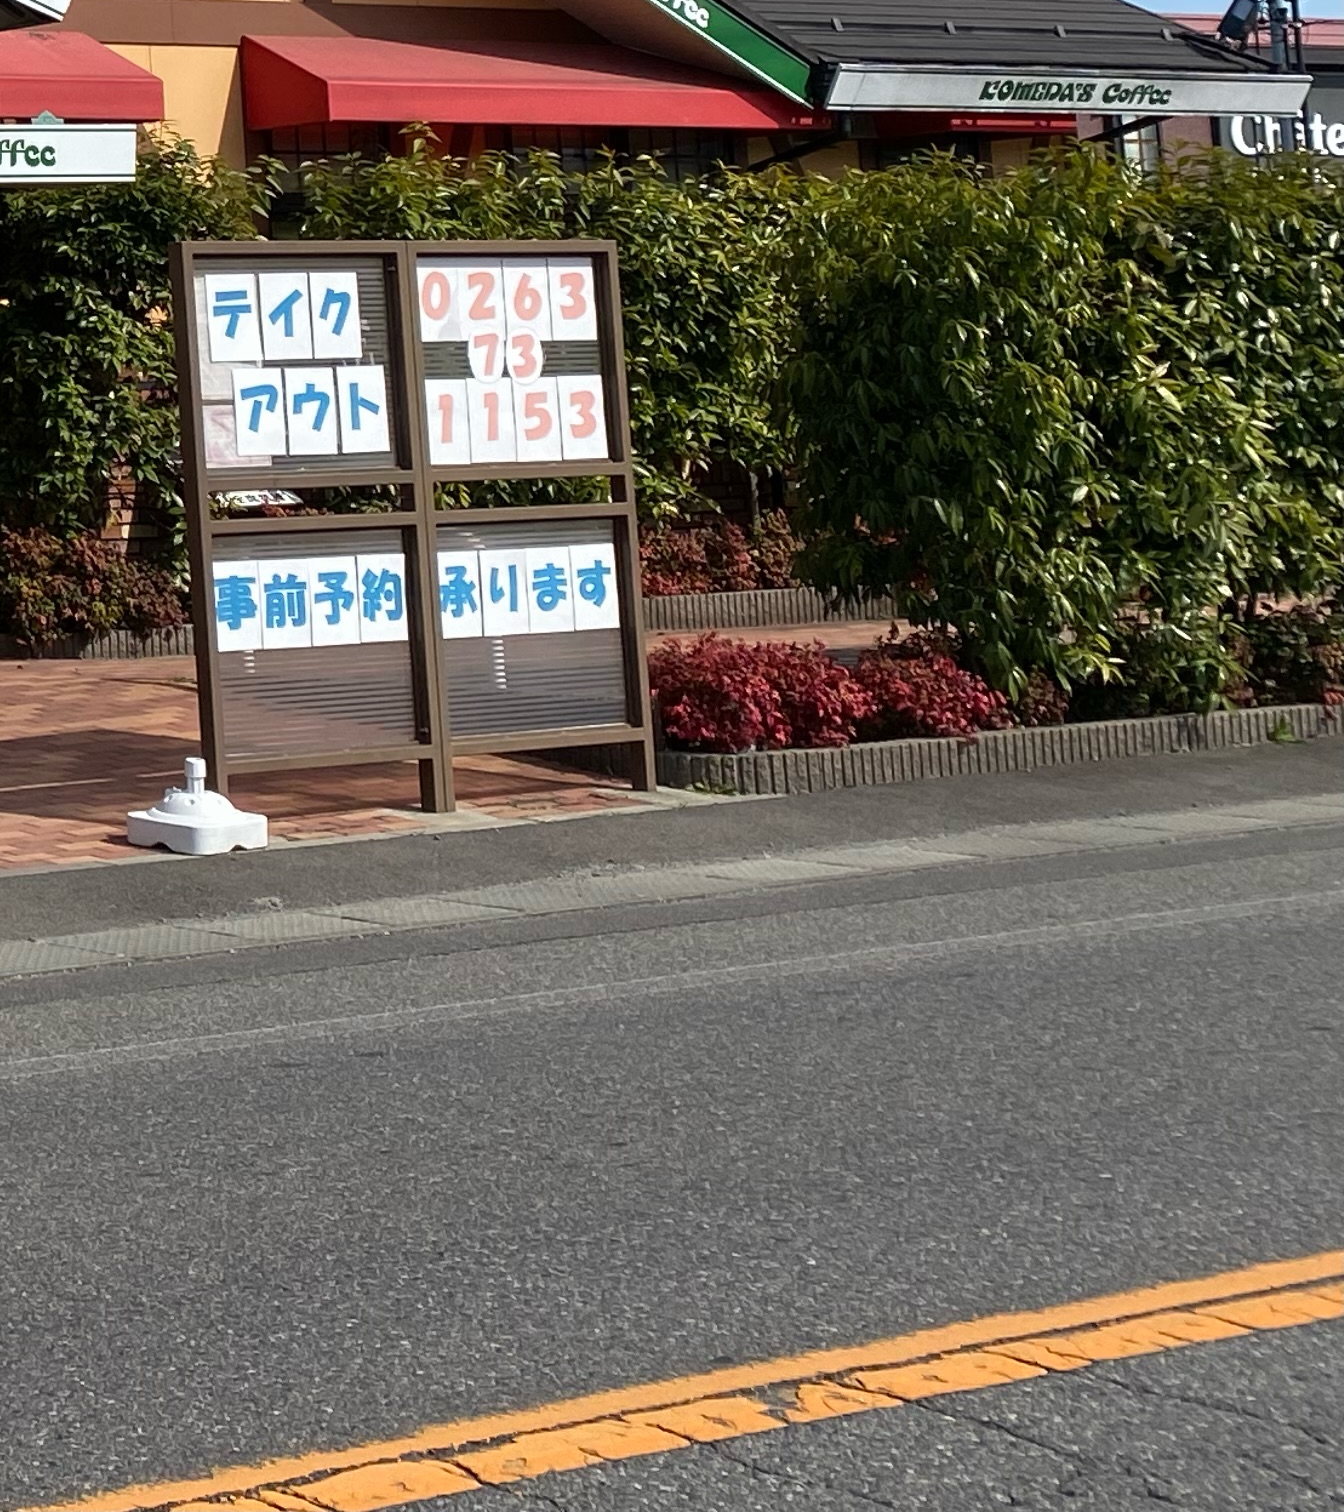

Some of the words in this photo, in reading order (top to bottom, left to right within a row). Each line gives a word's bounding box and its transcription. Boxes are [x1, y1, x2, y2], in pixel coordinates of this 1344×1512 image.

[978, 80, 1097, 103] KOMEDA'S
[1101, 82, 1173, 105] Coffee
[212, 288, 352, 339] テイク
[421, 271, 588, 320] 0263
[473, 333, 538, 378] 73
[240, 382, 380, 433] アウト
[438, 390, 597, 444] 1153
[215, 567, 403, 630] 事前予約
[439, 558, 612, 619] 承ります
